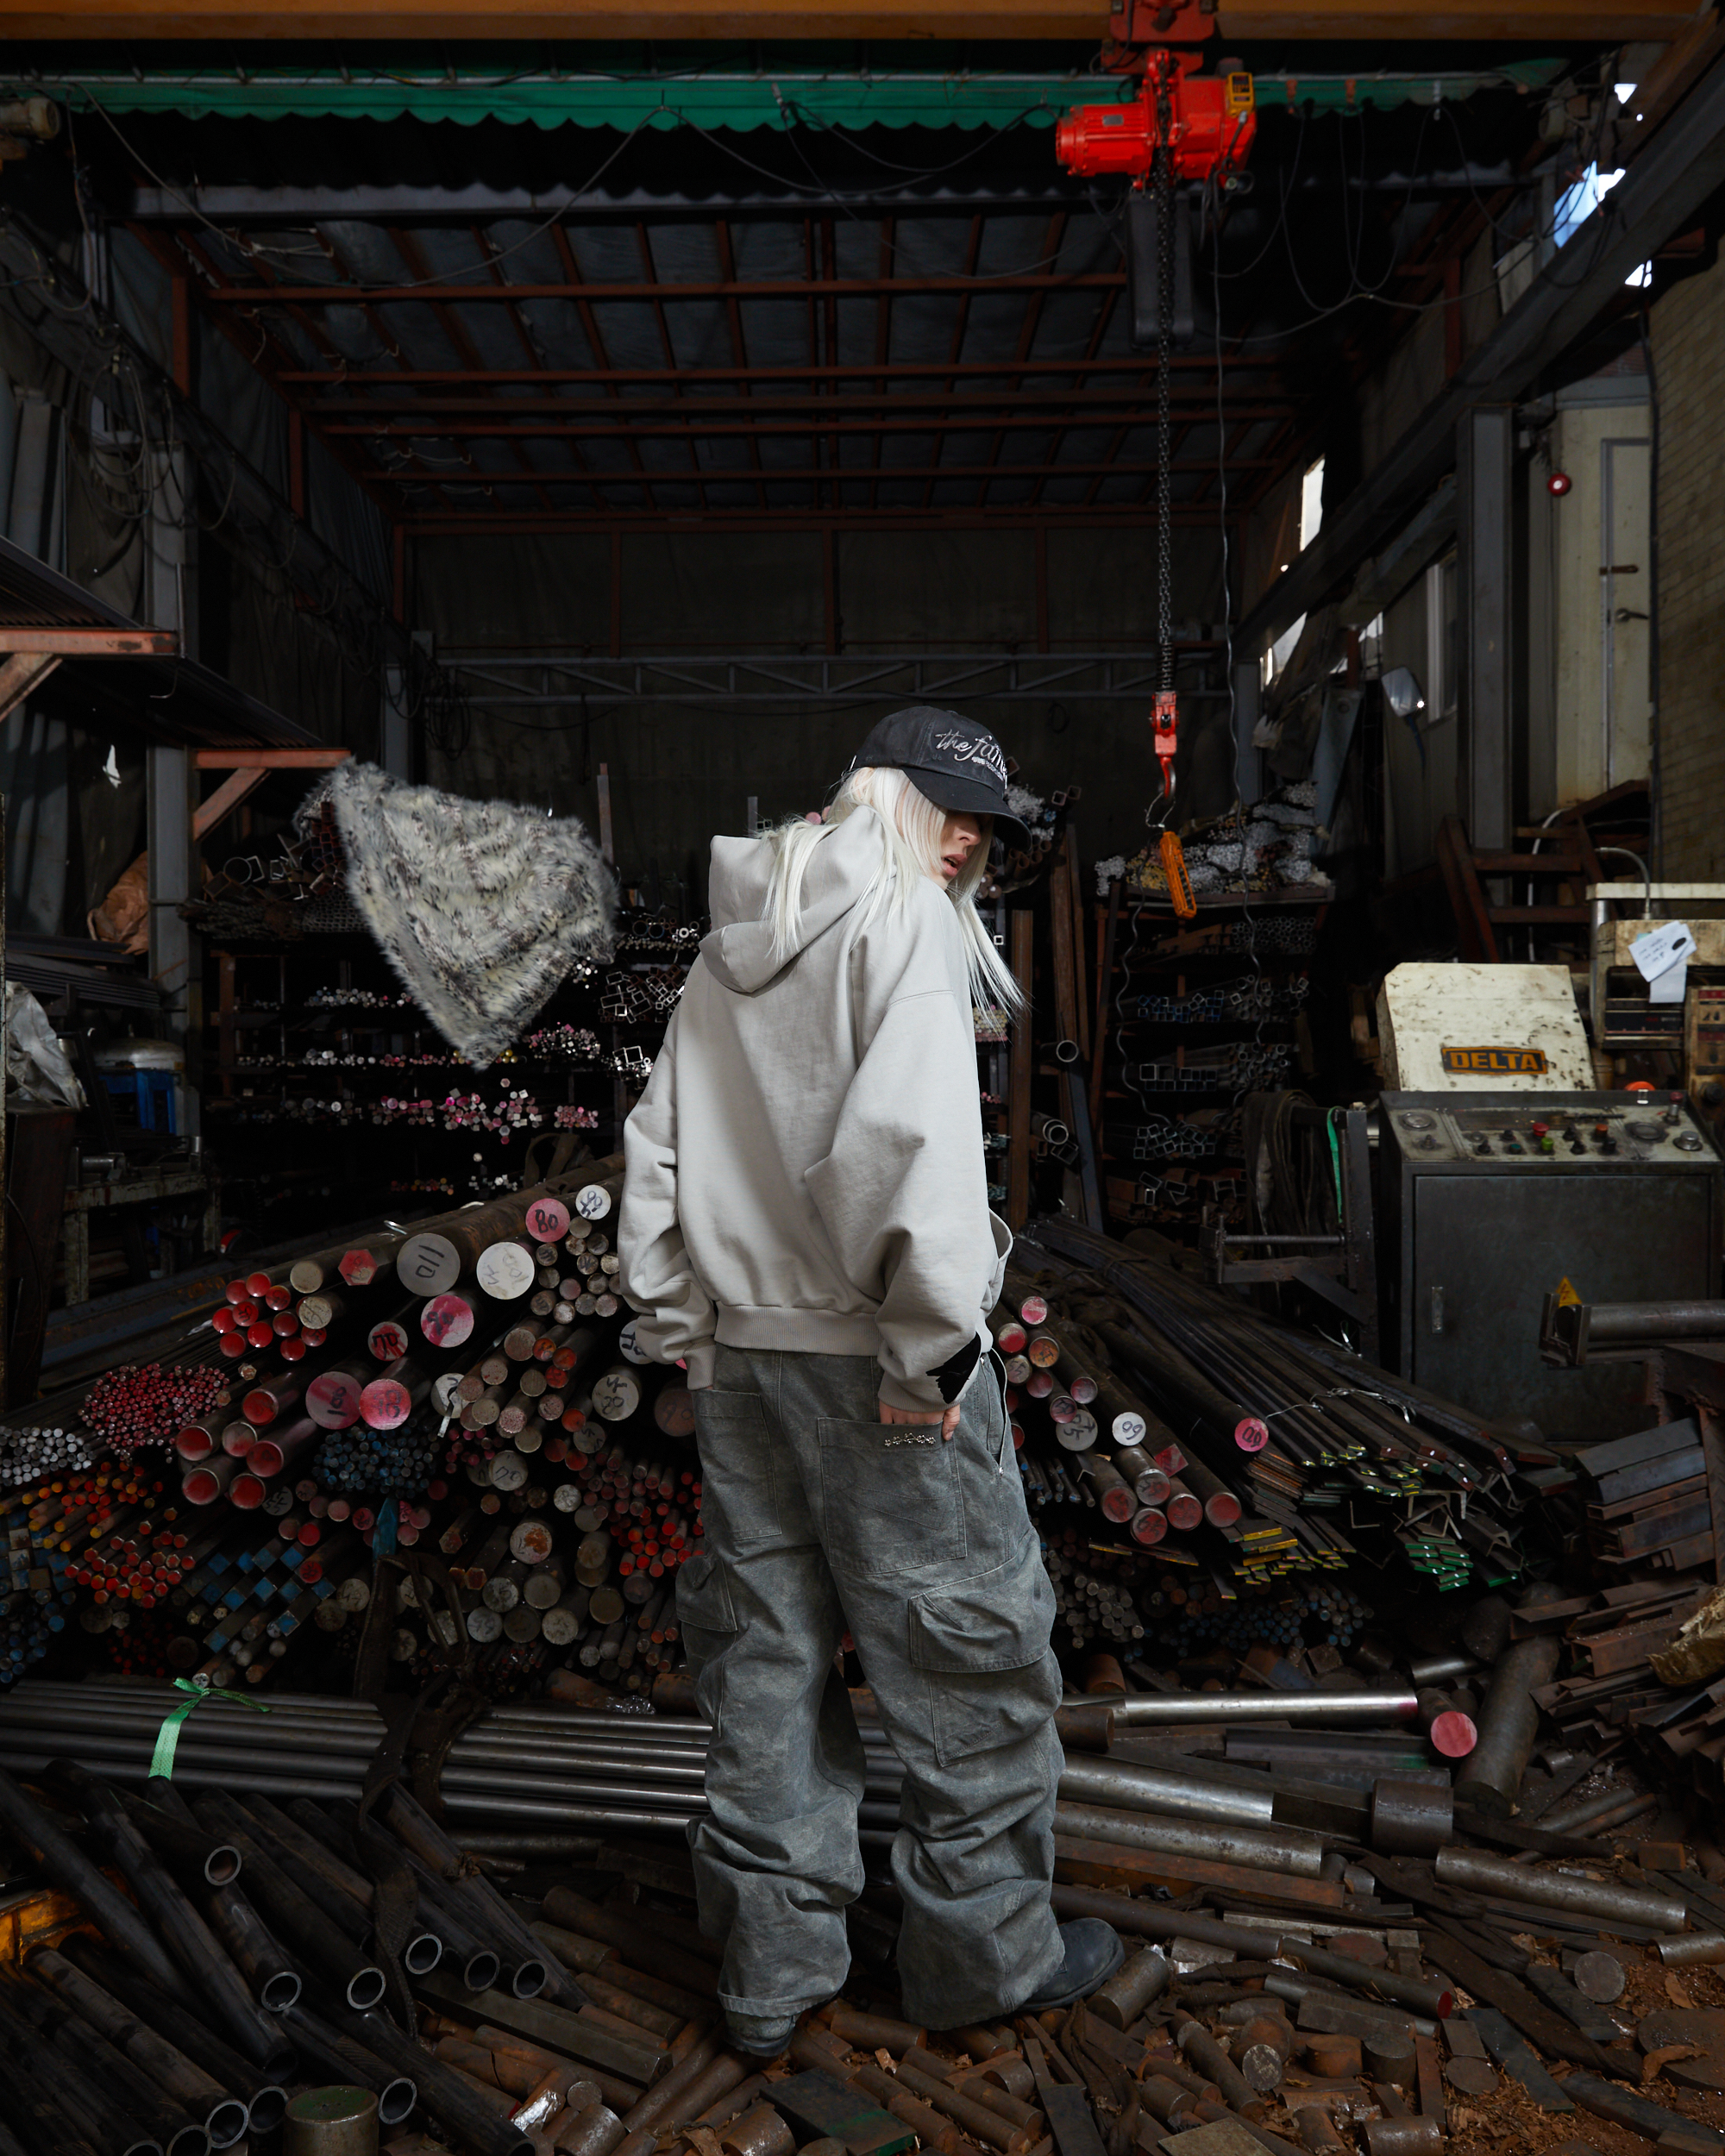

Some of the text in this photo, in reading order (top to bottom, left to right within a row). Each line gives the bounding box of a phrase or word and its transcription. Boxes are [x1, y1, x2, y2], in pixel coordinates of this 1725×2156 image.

[1450, 1051, 1540, 1071] DELTA
[535, 1209, 559, 1233] 80
[427, 1311, 455, 1336] 90
[372, 1332, 398, 1359] 70
